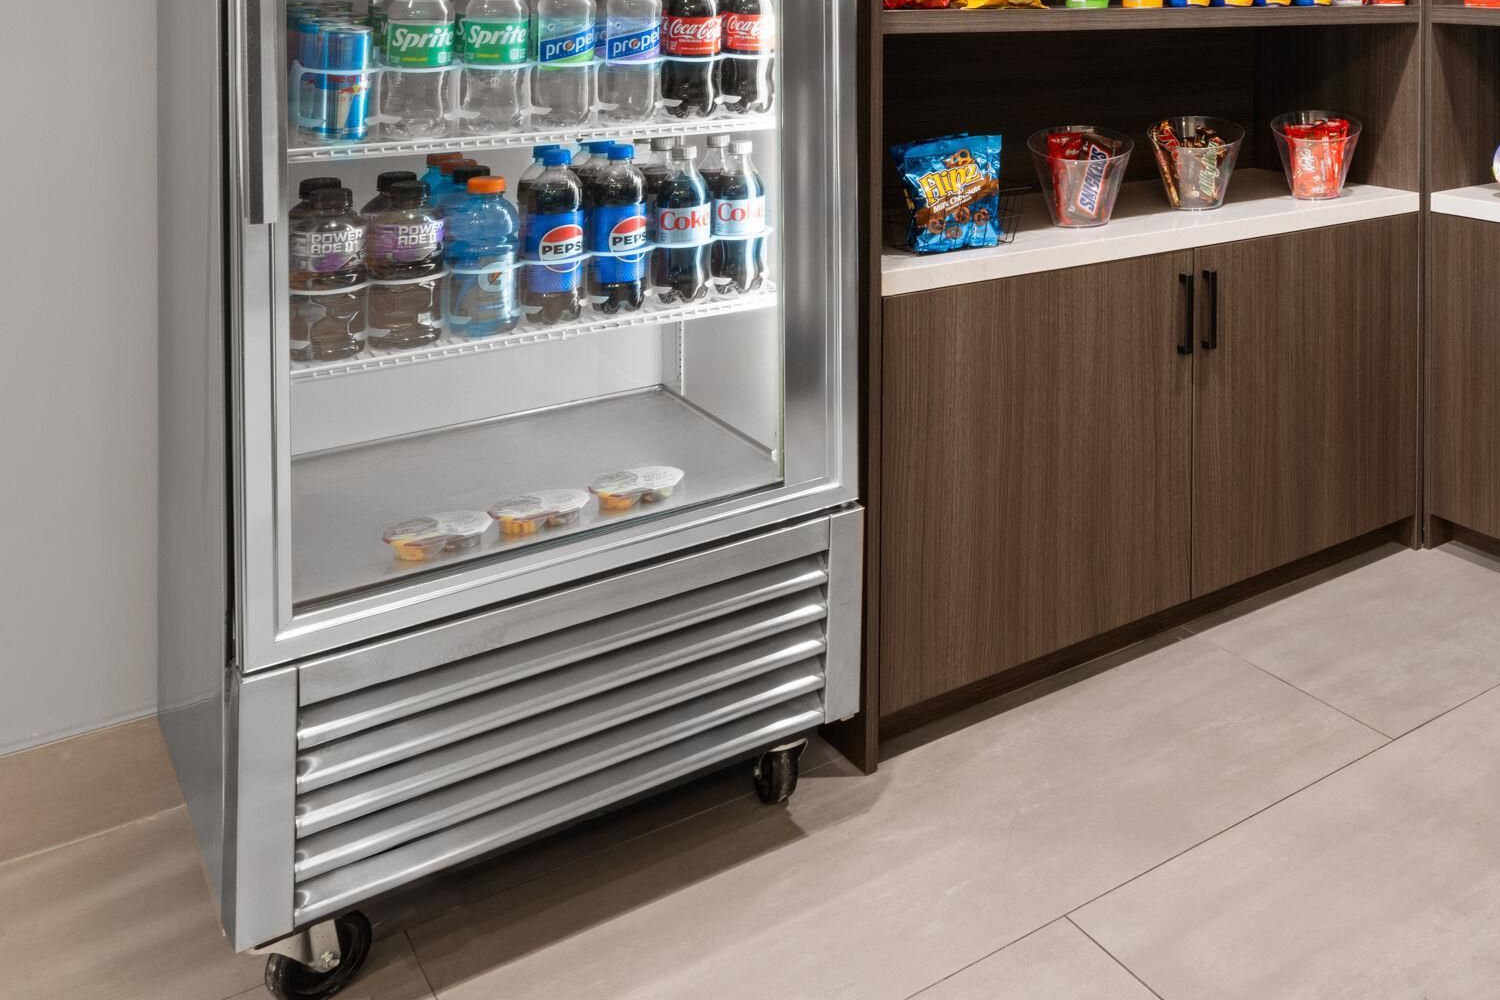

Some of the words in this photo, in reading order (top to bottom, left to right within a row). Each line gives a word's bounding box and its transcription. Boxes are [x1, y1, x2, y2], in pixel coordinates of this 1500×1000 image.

[392, 27, 455, 51] Sprite
[468, 25, 527, 48] Sprite
[546, 26, 593, 56] propel
[613, 26, 660, 56] propel
[1080, 147, 1107, 212] SNICKERS
[399, 221, 444, 235] POWER
[660, 210, 709, 231] Coke
[311, 228, 363, 244] POWER
[612, 232, 646, 246] PEPS
[542, 241, 583, 255] PEPS
